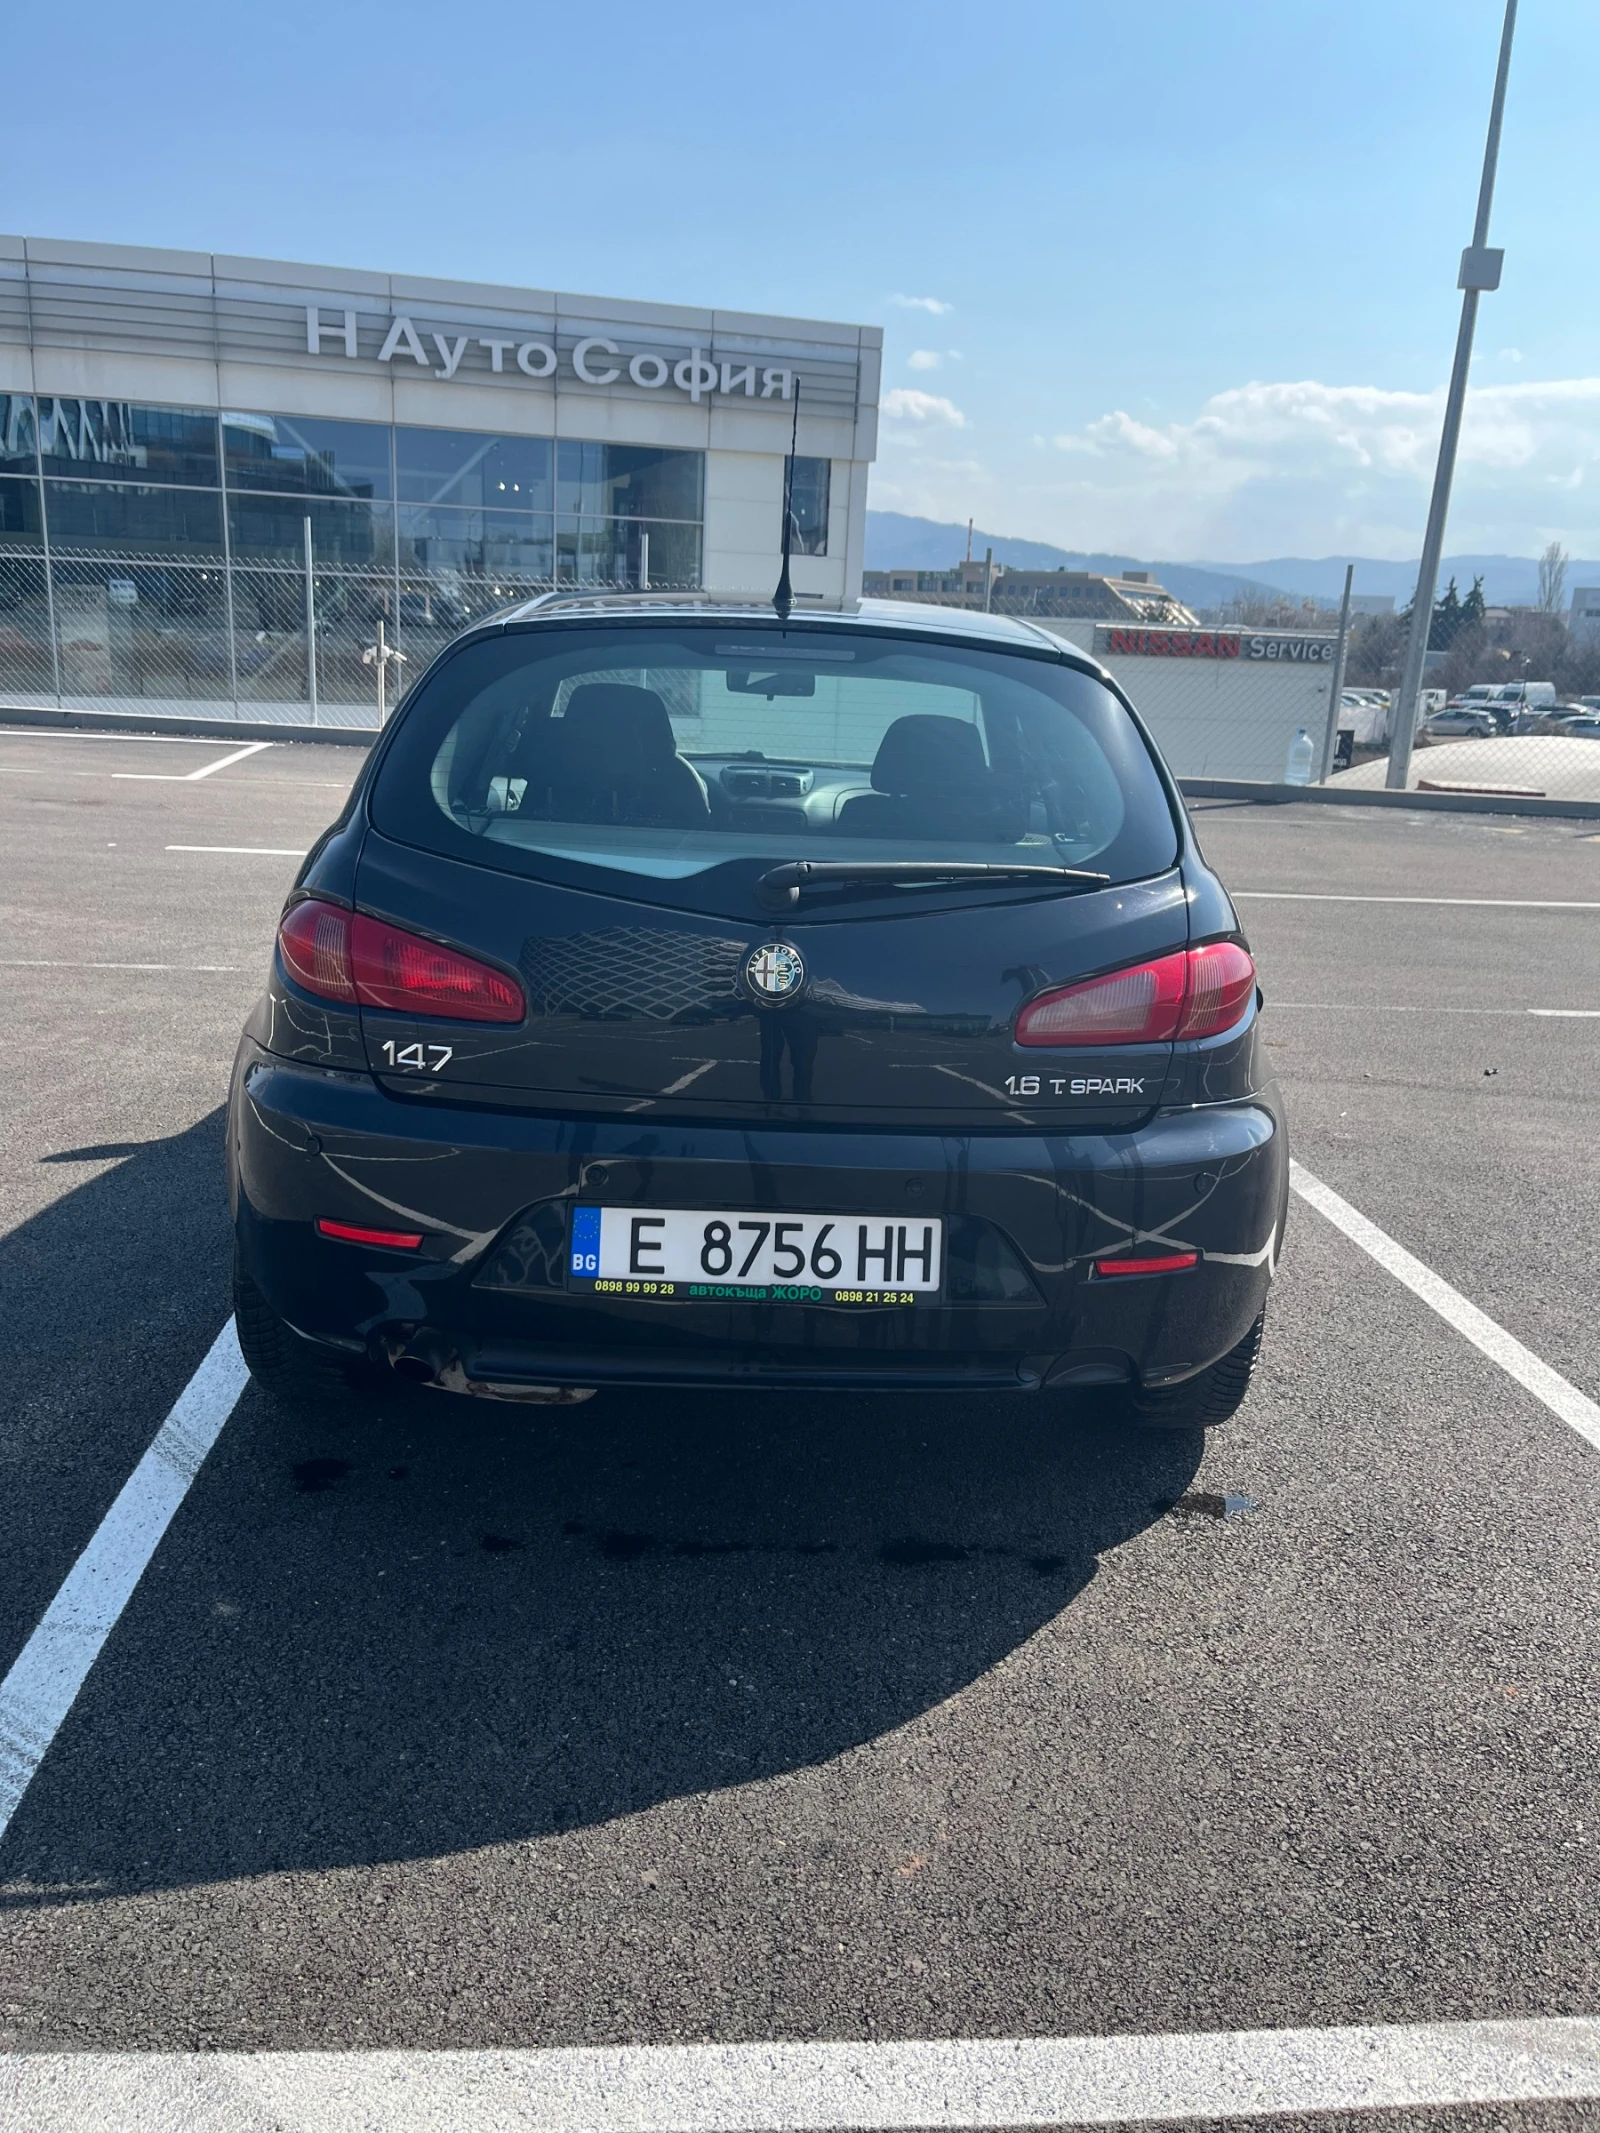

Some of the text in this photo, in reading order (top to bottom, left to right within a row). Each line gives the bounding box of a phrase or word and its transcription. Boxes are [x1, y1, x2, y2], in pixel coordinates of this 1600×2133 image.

[377, 315, 558, 379] Ауто
[572, 337, 794, 403] София
[1110, 630, 1333, 661] NISSAN Service
[749, 946, 802, 974] ALFA ROMEO
[382, 1040, 453, 1072] 147
[1070, 1078, 1145, 1095] SPARK
[629, 1218, 933, 1282] E 8756 HH
[572, 1253, 597, 1271] BG
[594, 1280, 674, 1295] 0898 99 99 28
[689, 1285, 822, 1301] автокъща ЖОРО
[835, 1290, 914, 1303] 0898 21 25 24
